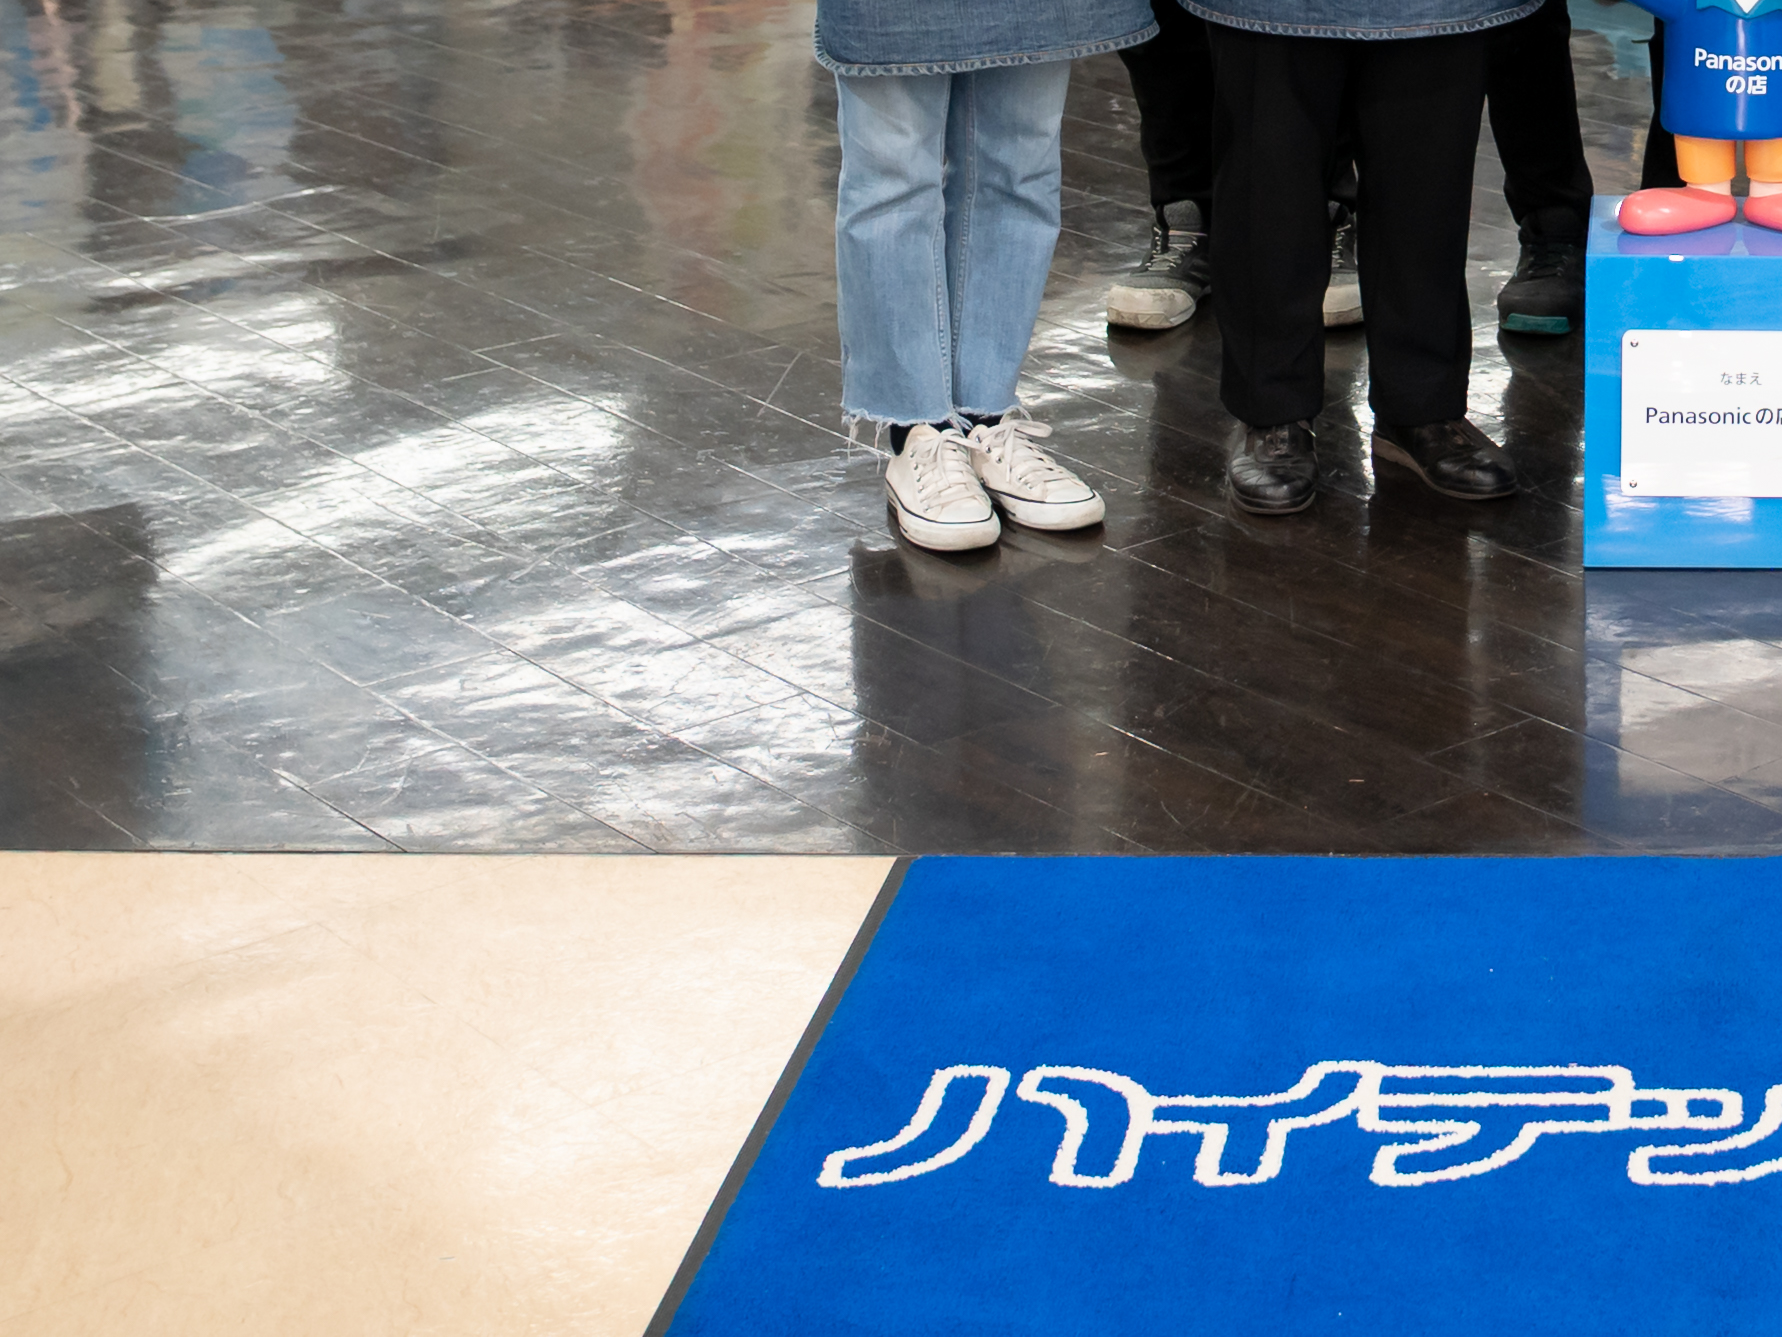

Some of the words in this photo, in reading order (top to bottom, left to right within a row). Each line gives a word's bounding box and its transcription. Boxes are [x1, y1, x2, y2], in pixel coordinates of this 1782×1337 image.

[1725, 74, 1768, 95] の店
[1720, 371, 1763, 386] なまえ
